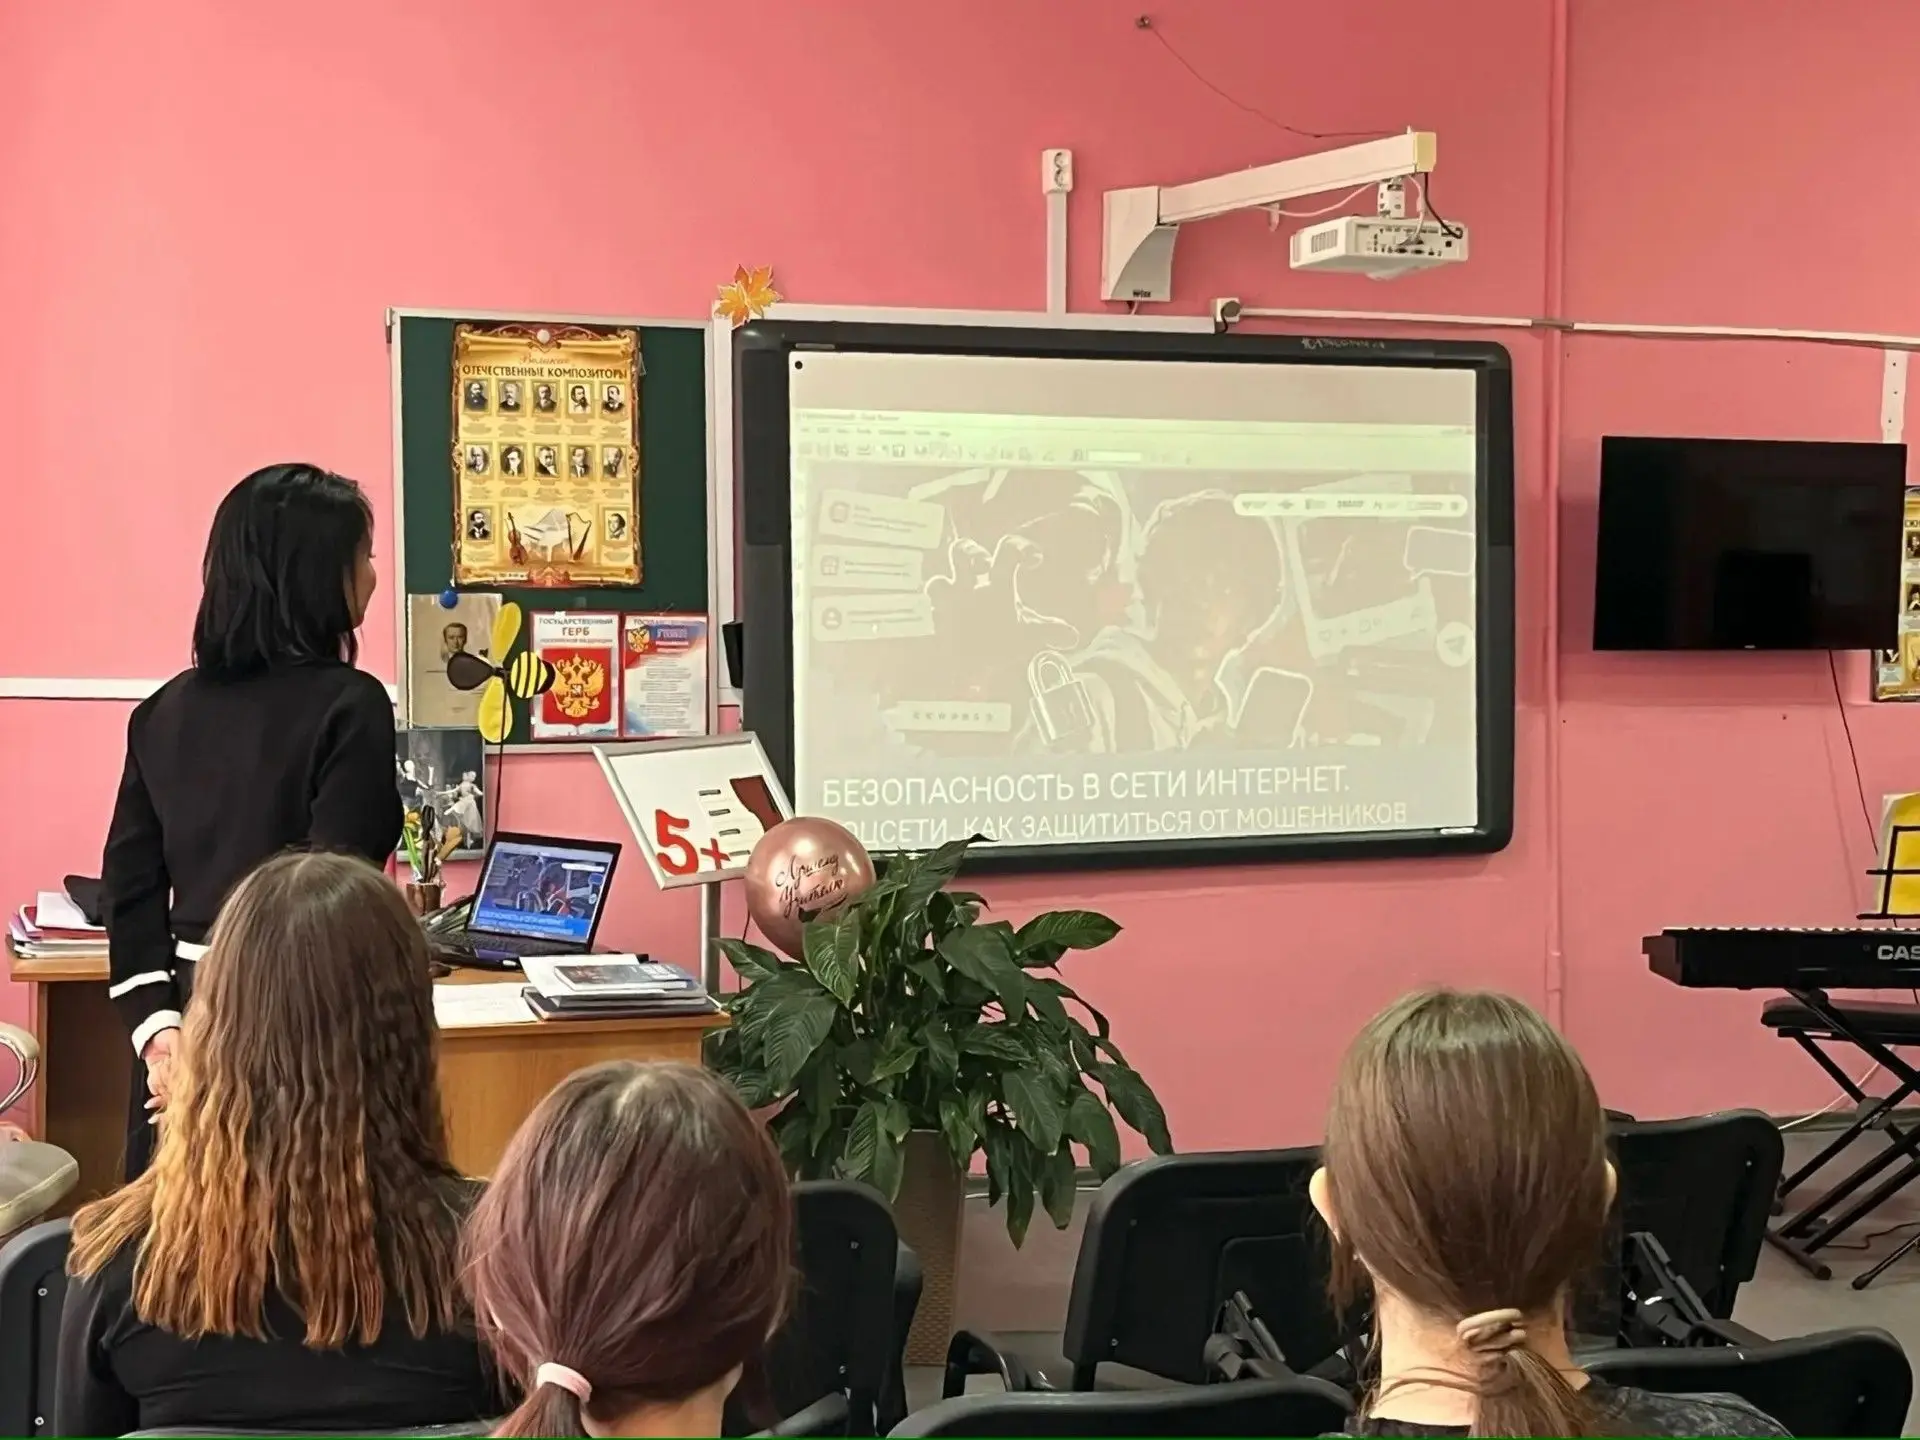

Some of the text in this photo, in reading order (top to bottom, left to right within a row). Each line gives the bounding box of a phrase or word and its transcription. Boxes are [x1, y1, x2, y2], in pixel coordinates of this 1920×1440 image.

[462, 364, 628, 379] ОТЕЧЕСТВЕННЫЕ КОМПОЗИТОРЫ
[562, 626, 590, 636] ГЕРБ
[822, 765, 1350, 807] БЕЗОПАСНОСТЬ В СЕТИ ИНТЕРНЕТ.
[841, 801, 1407, 846] ОЦСЕТИ. КАК ЗАЩИТИТЬСЯ ОТ МОШЕННИКОВ
